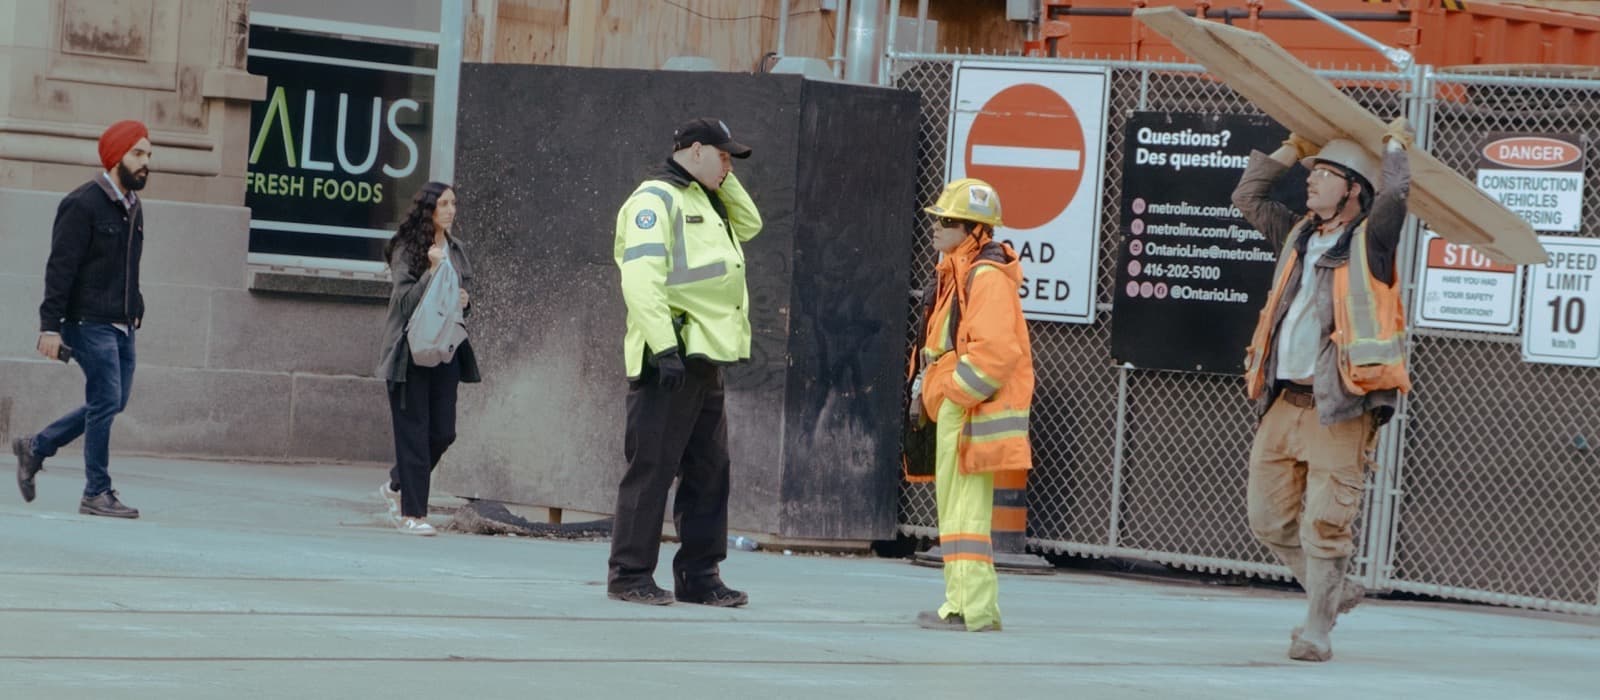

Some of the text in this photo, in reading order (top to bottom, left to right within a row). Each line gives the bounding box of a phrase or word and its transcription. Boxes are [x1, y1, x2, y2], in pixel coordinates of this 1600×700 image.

[249, 86, 419, 178] ALUS
[1137, 127, 1232, 147] Questions?
[1136, 148, 1167, 166] Des
[1499, 145, 1564, 160] DANGER
[246, 172, 383, 204] FRESH FOODS
[1482, 176, 1578, 192] CONSTRUCTION
[1500, 192, 1558, 208] VEHICLES
[1148, 201, 1244, 218] metrolinx.com/o
[1002, 240, 1055, 263] AD
[1145, 242, 1276, 262] OntarioLine@metrolinx.
[1545, 251, 1597, 271] SPEED
[1144, 263, 1221, 280] 416-202-5100
[1018, 277, 1070, 301] SED
[1463, 277, 1480, 285] YOU
[1546, 273, 1592, 291] LIMIT
[1170, 285, 1249, 302] @OntarioLine
[1465, 292, 1494, 301] SAFETY
[1548, 295, 1585, 334] 10
[1551, 339, 1576, 349] km/h
